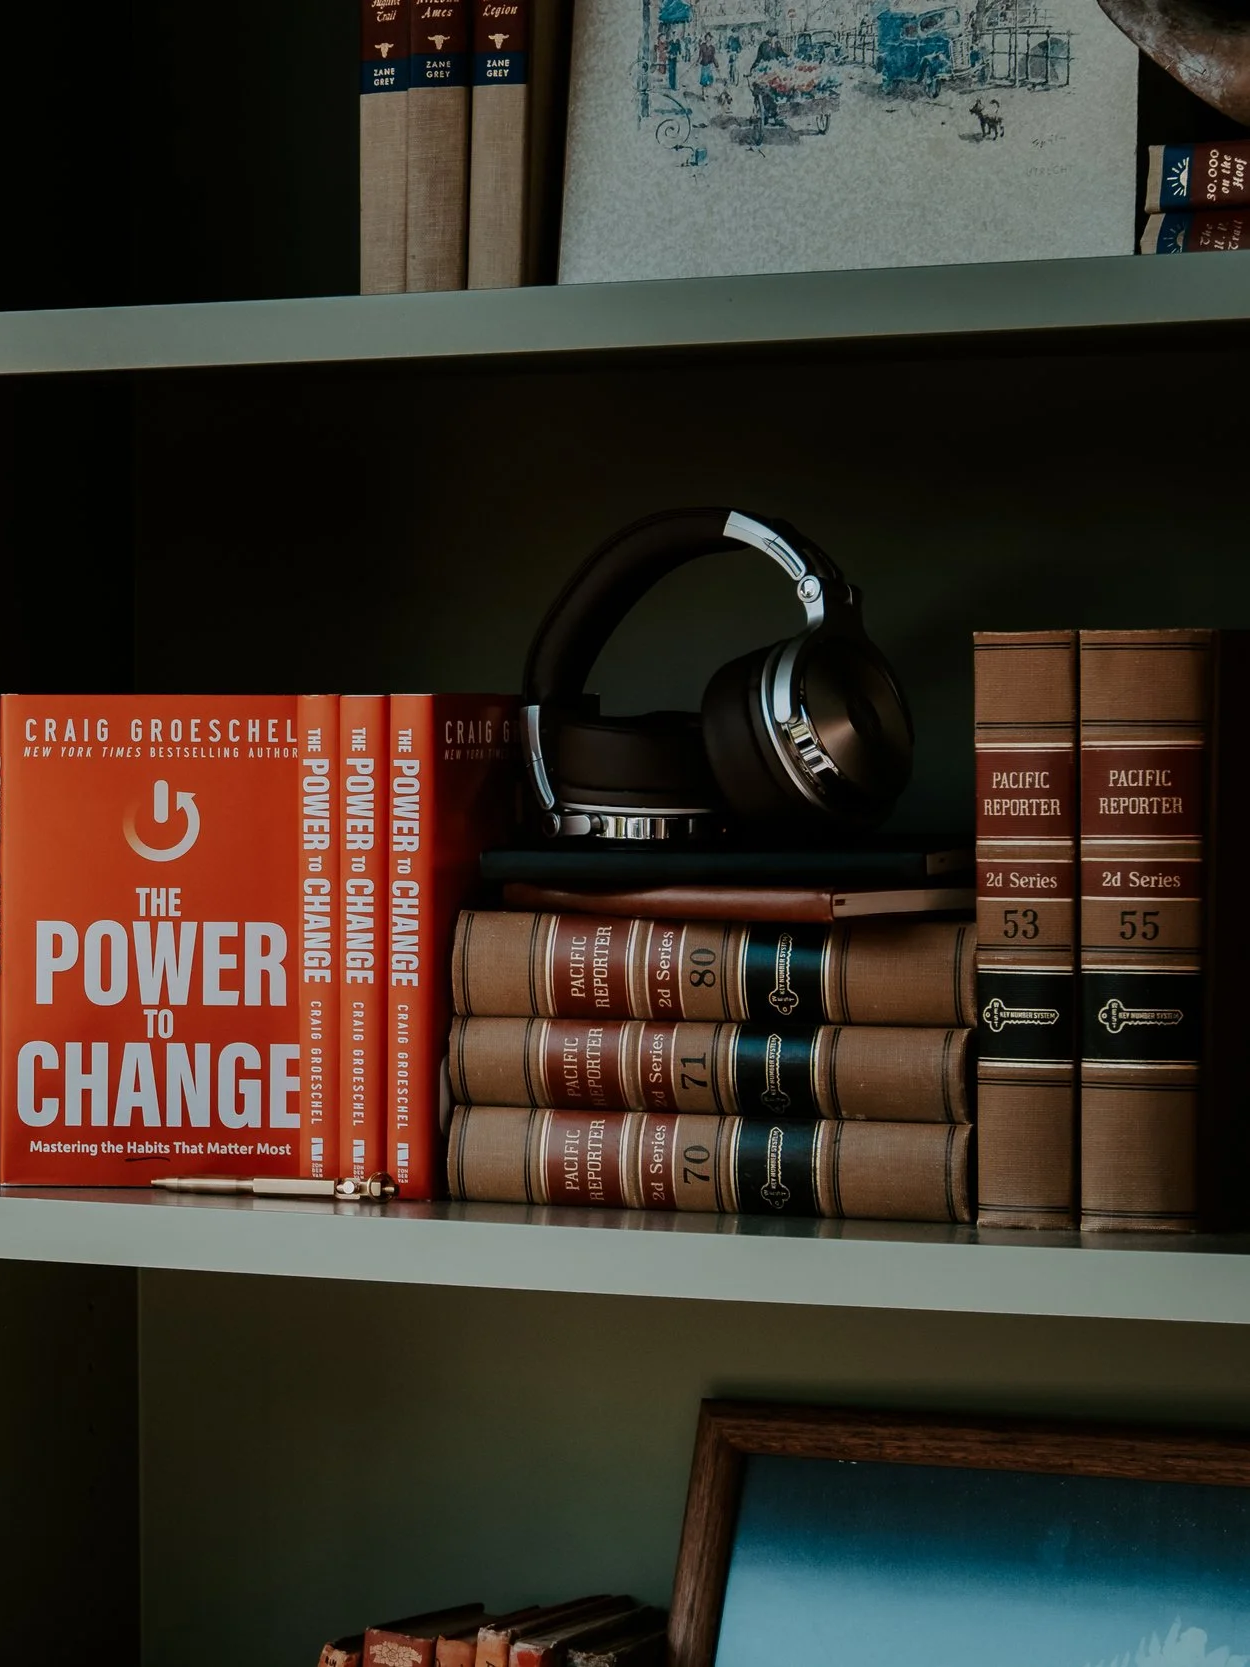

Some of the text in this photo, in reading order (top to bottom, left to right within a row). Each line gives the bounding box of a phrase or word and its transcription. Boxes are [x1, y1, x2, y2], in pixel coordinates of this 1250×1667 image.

[376, 9, 397, 22] Trail
[421, 6, 453, 19] Ames
[482, 4, 518, 18] Legion
[373, 67, 395, 77] ZANE
[425, 70, 450, 79] GREY
[426, 60, 451, 69] ZANE
[486, 59, 510, 68] ZANE
[486, 68, 510, 78] GREY
[373, 77, 395, 87] GREY
[1220, 154, 1232, 194] on the
[1232, 157, 1248, 191] Hoof
[25, 718, 297, 743] CRAIG GROESCHEL
[445, 720, 492, 745] CRAIG
[23, 746, 298, 759] NEW YORK TIMES BESTSELLING AUTHOR
[444, 749, 462, 760] NEW
[992, 771, 1050, 789] PACIFIC
[1108, 769, 1171, 787] PACIFIC
[983, 798, 1060, 816] REPORTER
[1098, 796, 1181, 815] REPORTER
[302, 727, 332, 983] THE POWER TO CHANGE
[345, 727, 375, 983] THE POWER TO CHANGE
[391, 728, 421, 986] THE POWER TO CHANGE
[986, 871, 1058, 889] 2d Series
[1102, 871, 1181, 888] 2d Series
[135, 887, 182, 917] THE
[1003, 908, 1040, 940] 53
[1119, 910, 1161, 941] 55
[35, 919, 287, 1006] POWER
[569, 936, 588, 997] PACIFIC
[592, 925, 613, 1007] REPORTER
[656, 931, 674, 1008] 2d Series
[688, 948, 717, 988] 80
[143, 1008, 174, 1039] TO
[310, 1000, 323, 1124] CRAIG GROESCHEL
[352, 1001, 365, 1126] CRAIG GROESCHEL
[396, 1004, 409, 1129] CRAIG GROESCHEL
[562, 1036, 581, 1099] PACIFIC
[584, 1026, 605, 1109] REPORTER
[649, 1033, 665, 1083] Series
[678, 1052, 708, 1092] 71
[16, 1040, 300, 1129] CHANGE
[29, 1140, 292, 1157] Mastering the Habits That Matter Most
[562, 1128, 582, 1189] PACIFIC
[587, 1118, 606, 1201] REPORTER
[649, 1125, 667, 1200] 2d Series
[682, 1145, 711, 1185] 70
